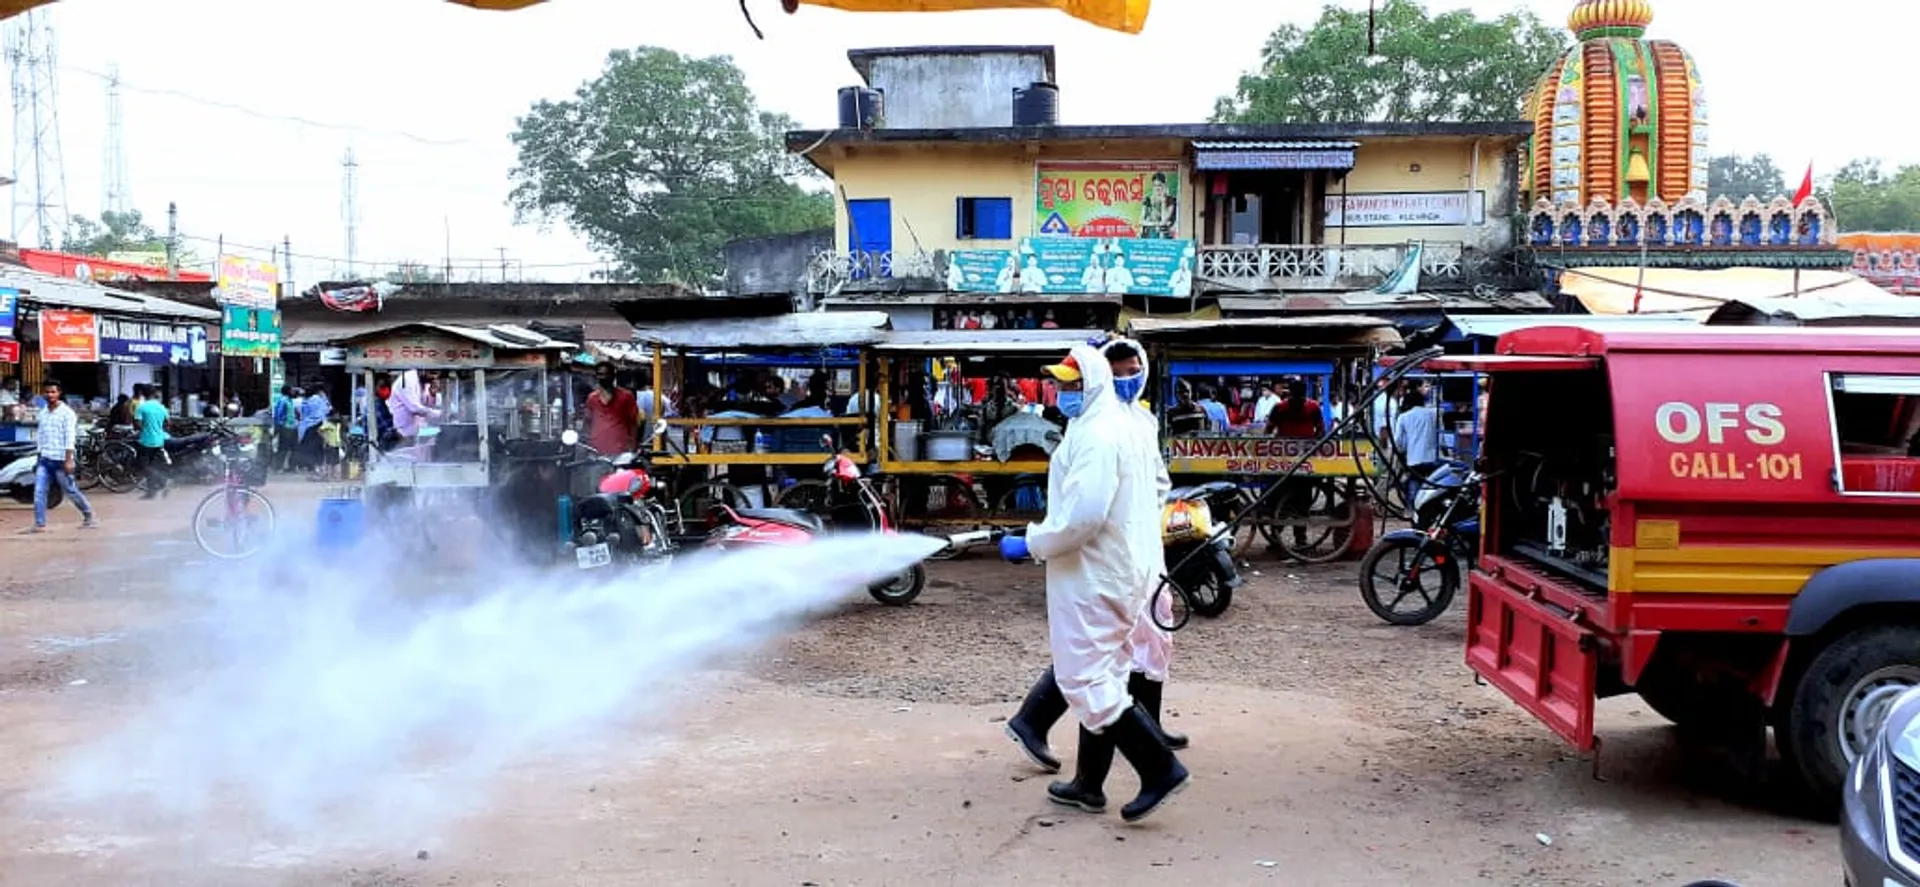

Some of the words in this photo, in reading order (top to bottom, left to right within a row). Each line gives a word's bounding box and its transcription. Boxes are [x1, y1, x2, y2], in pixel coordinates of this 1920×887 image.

[1656, 402, 1786, 445] OFS
[1171, 439, 1248, 458] NAYAK
[1254, 439, 1299, 458] EGG
